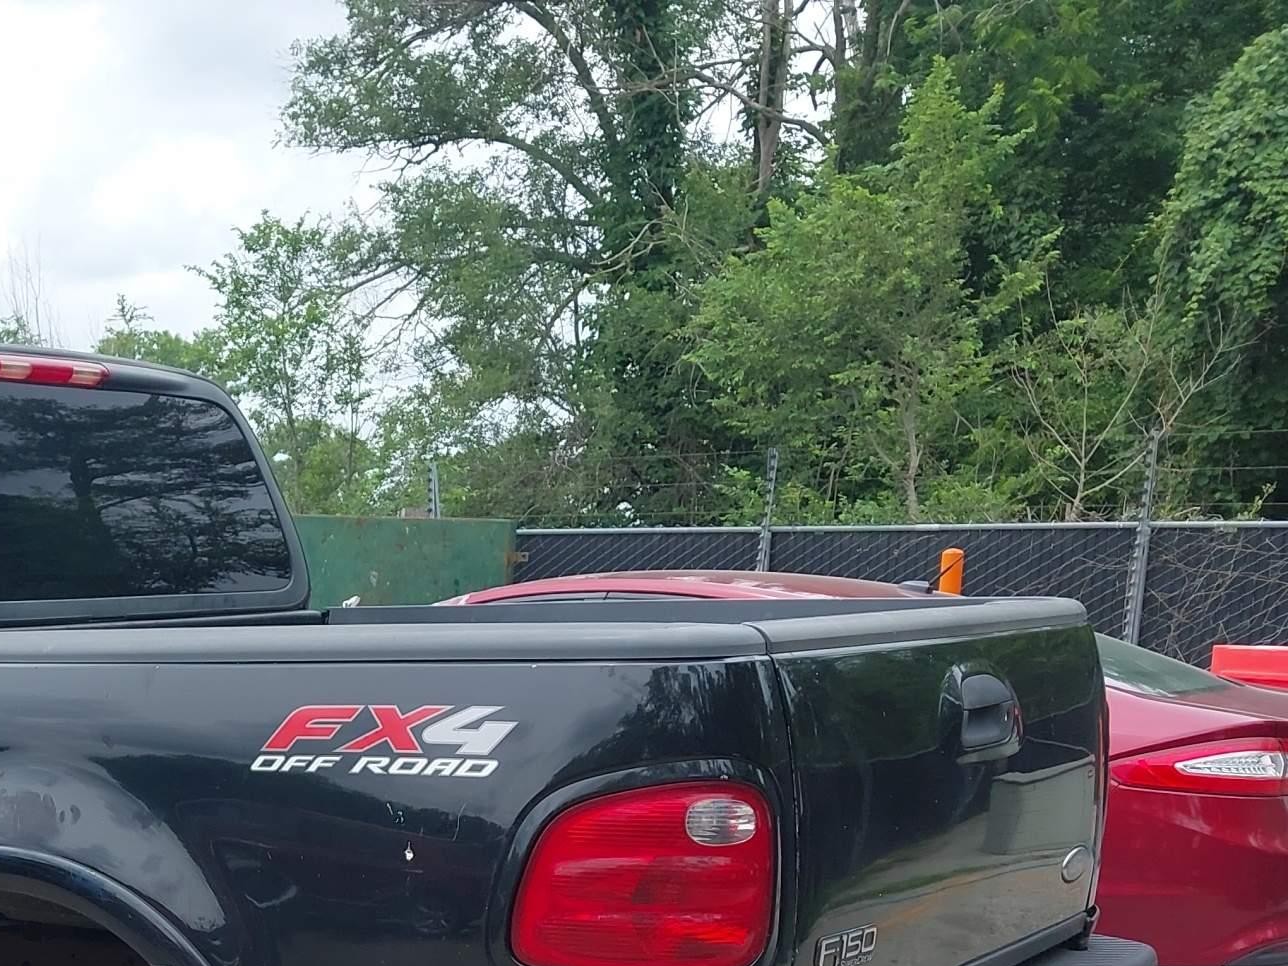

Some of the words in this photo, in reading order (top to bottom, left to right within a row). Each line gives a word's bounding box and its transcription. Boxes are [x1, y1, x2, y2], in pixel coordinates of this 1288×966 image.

[259, 704, 520, 756] FX4
[250, 754, 344, 774] OFF
[348, 755, 500, 778] ROAD
